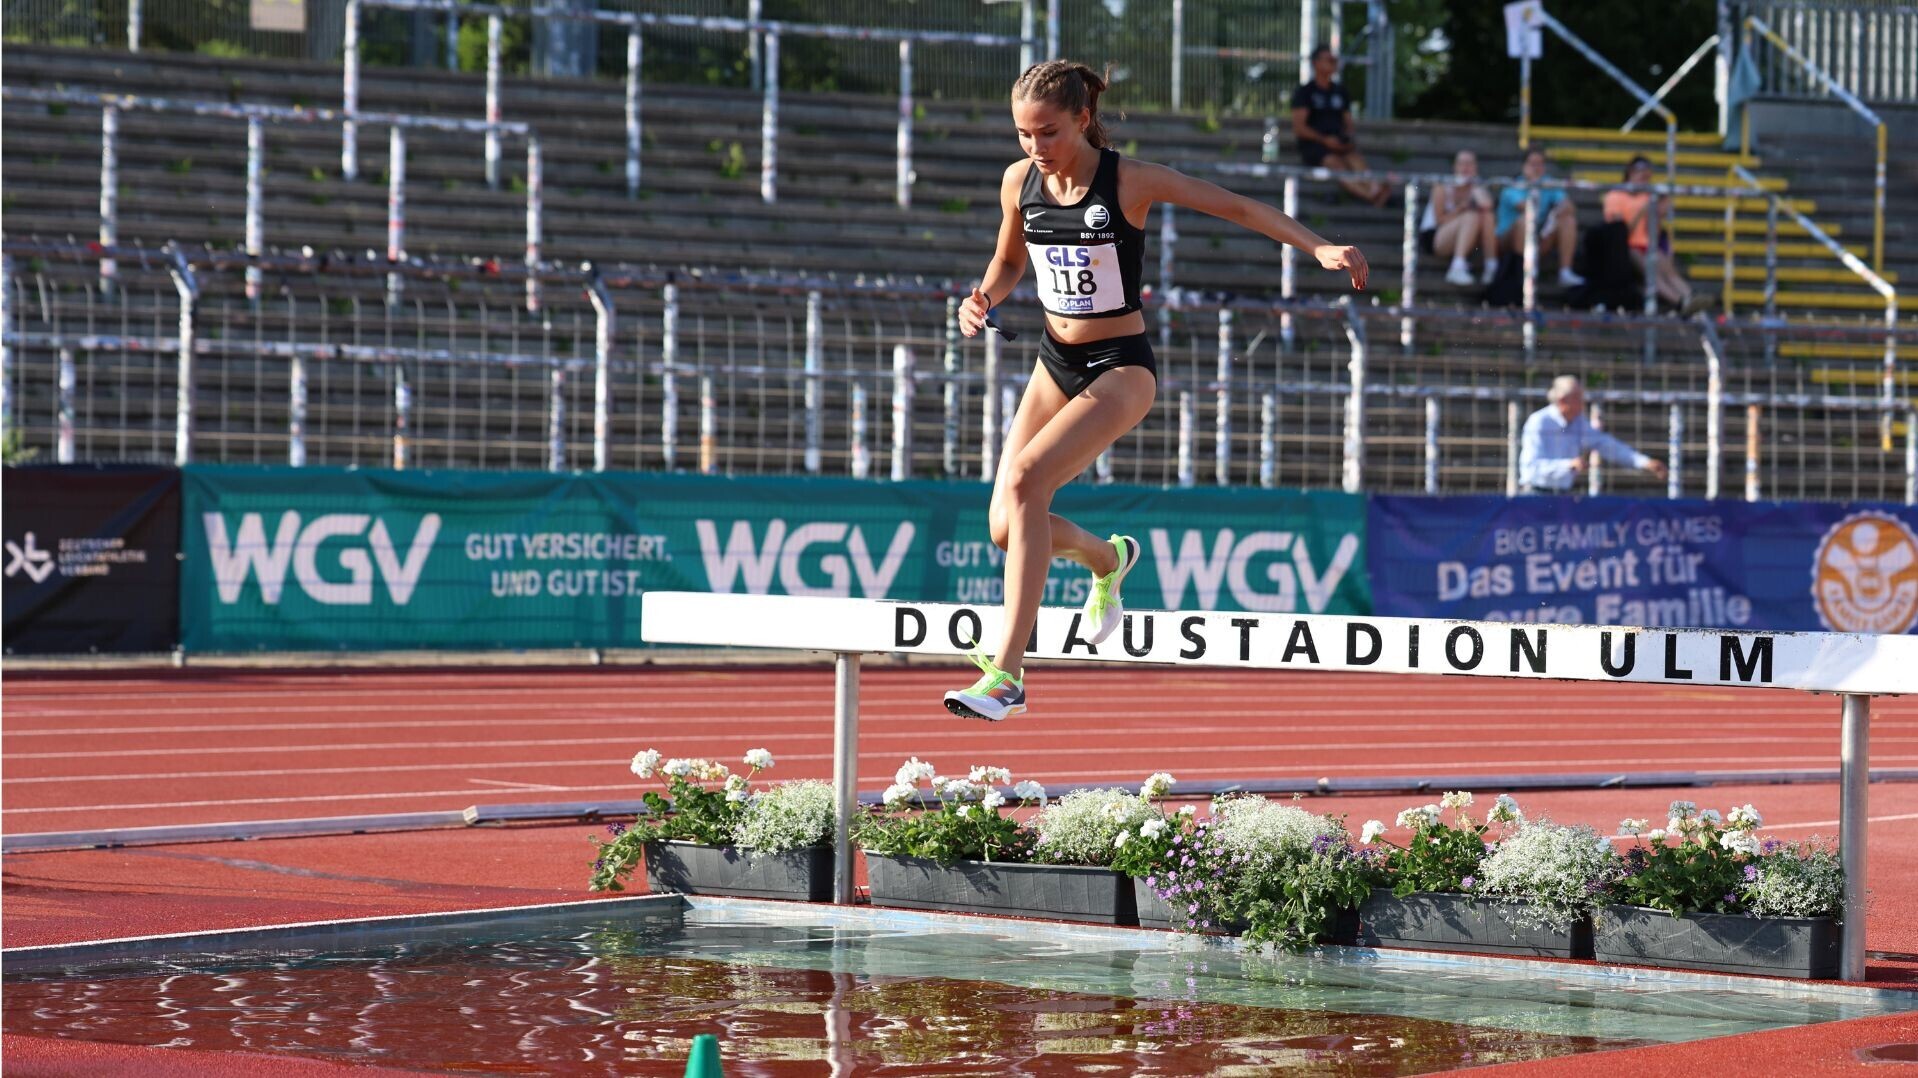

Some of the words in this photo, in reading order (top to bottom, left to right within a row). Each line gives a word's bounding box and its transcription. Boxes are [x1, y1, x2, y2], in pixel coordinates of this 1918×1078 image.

[1049, 267, 1097, 296] 118
[1070, 299, 1091, 307] PLAN
[465, 533, 517, 560] GUT
[521, 532, 672, 561] VERSICHERT.
[935, 541, 984, 567] GUT
[1494, 528, 1537, 555] BIG
[1543, 520, 1630, 551] FAMILY
[1636, 515, 1723, 546] GAMES
[202, 509, 442, 605] WGV
[695, 518, 916, 599] WGV
[1150, 528, 1359, 613] WGV
[1437, 561, 1514, 601] Das
[1525, 549, 1640, 594] Event
[1647, 545, 1705, 584] für
[491, 570, 542, 597] UND
[547, 569, 598, 597] GUT
[957, 575, 1004, 600] UND
[1595, 587, 1751, 627] Familie
[1600, 632, 1774, 682] ULM
